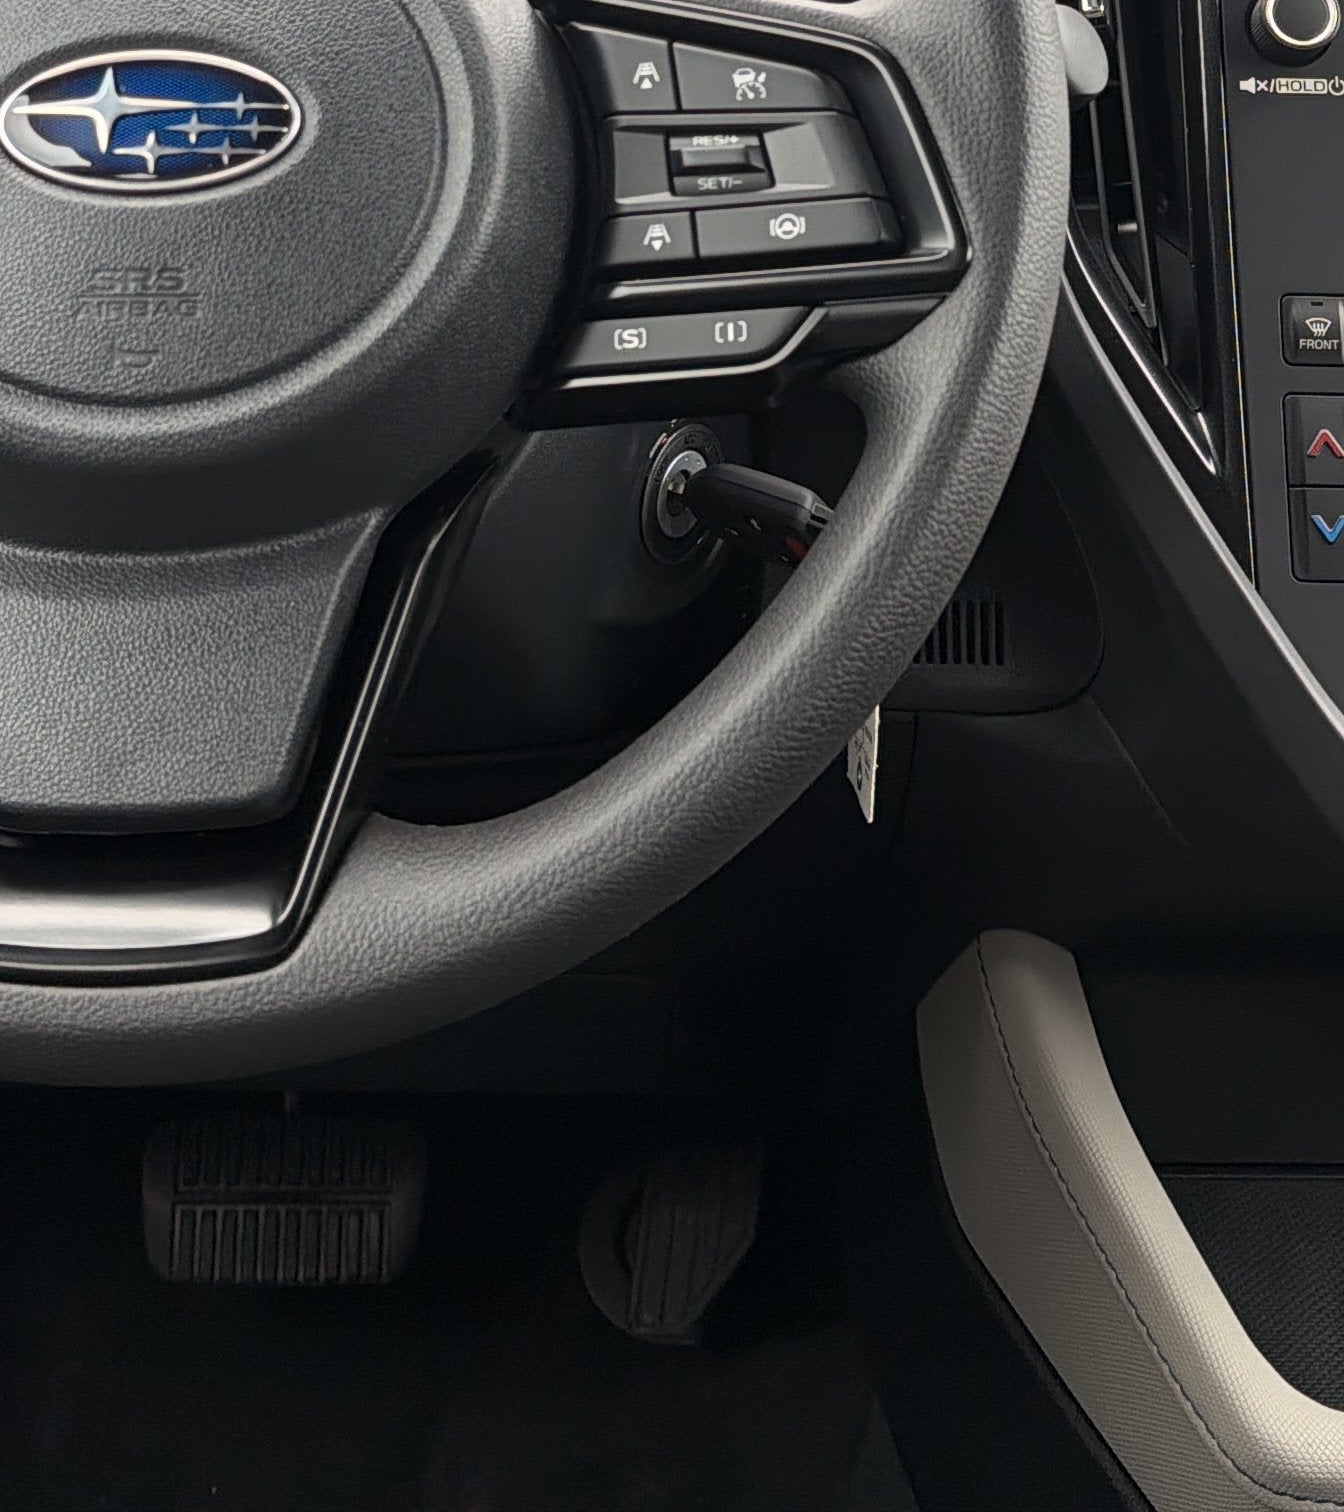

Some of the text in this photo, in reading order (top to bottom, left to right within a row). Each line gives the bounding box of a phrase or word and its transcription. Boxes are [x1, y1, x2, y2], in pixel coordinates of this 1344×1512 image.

[1276, 78, 1327, 94] HOLD
[90, 267, 189, 292] SRS
[1298, 338, 1340, 351] FRONT
